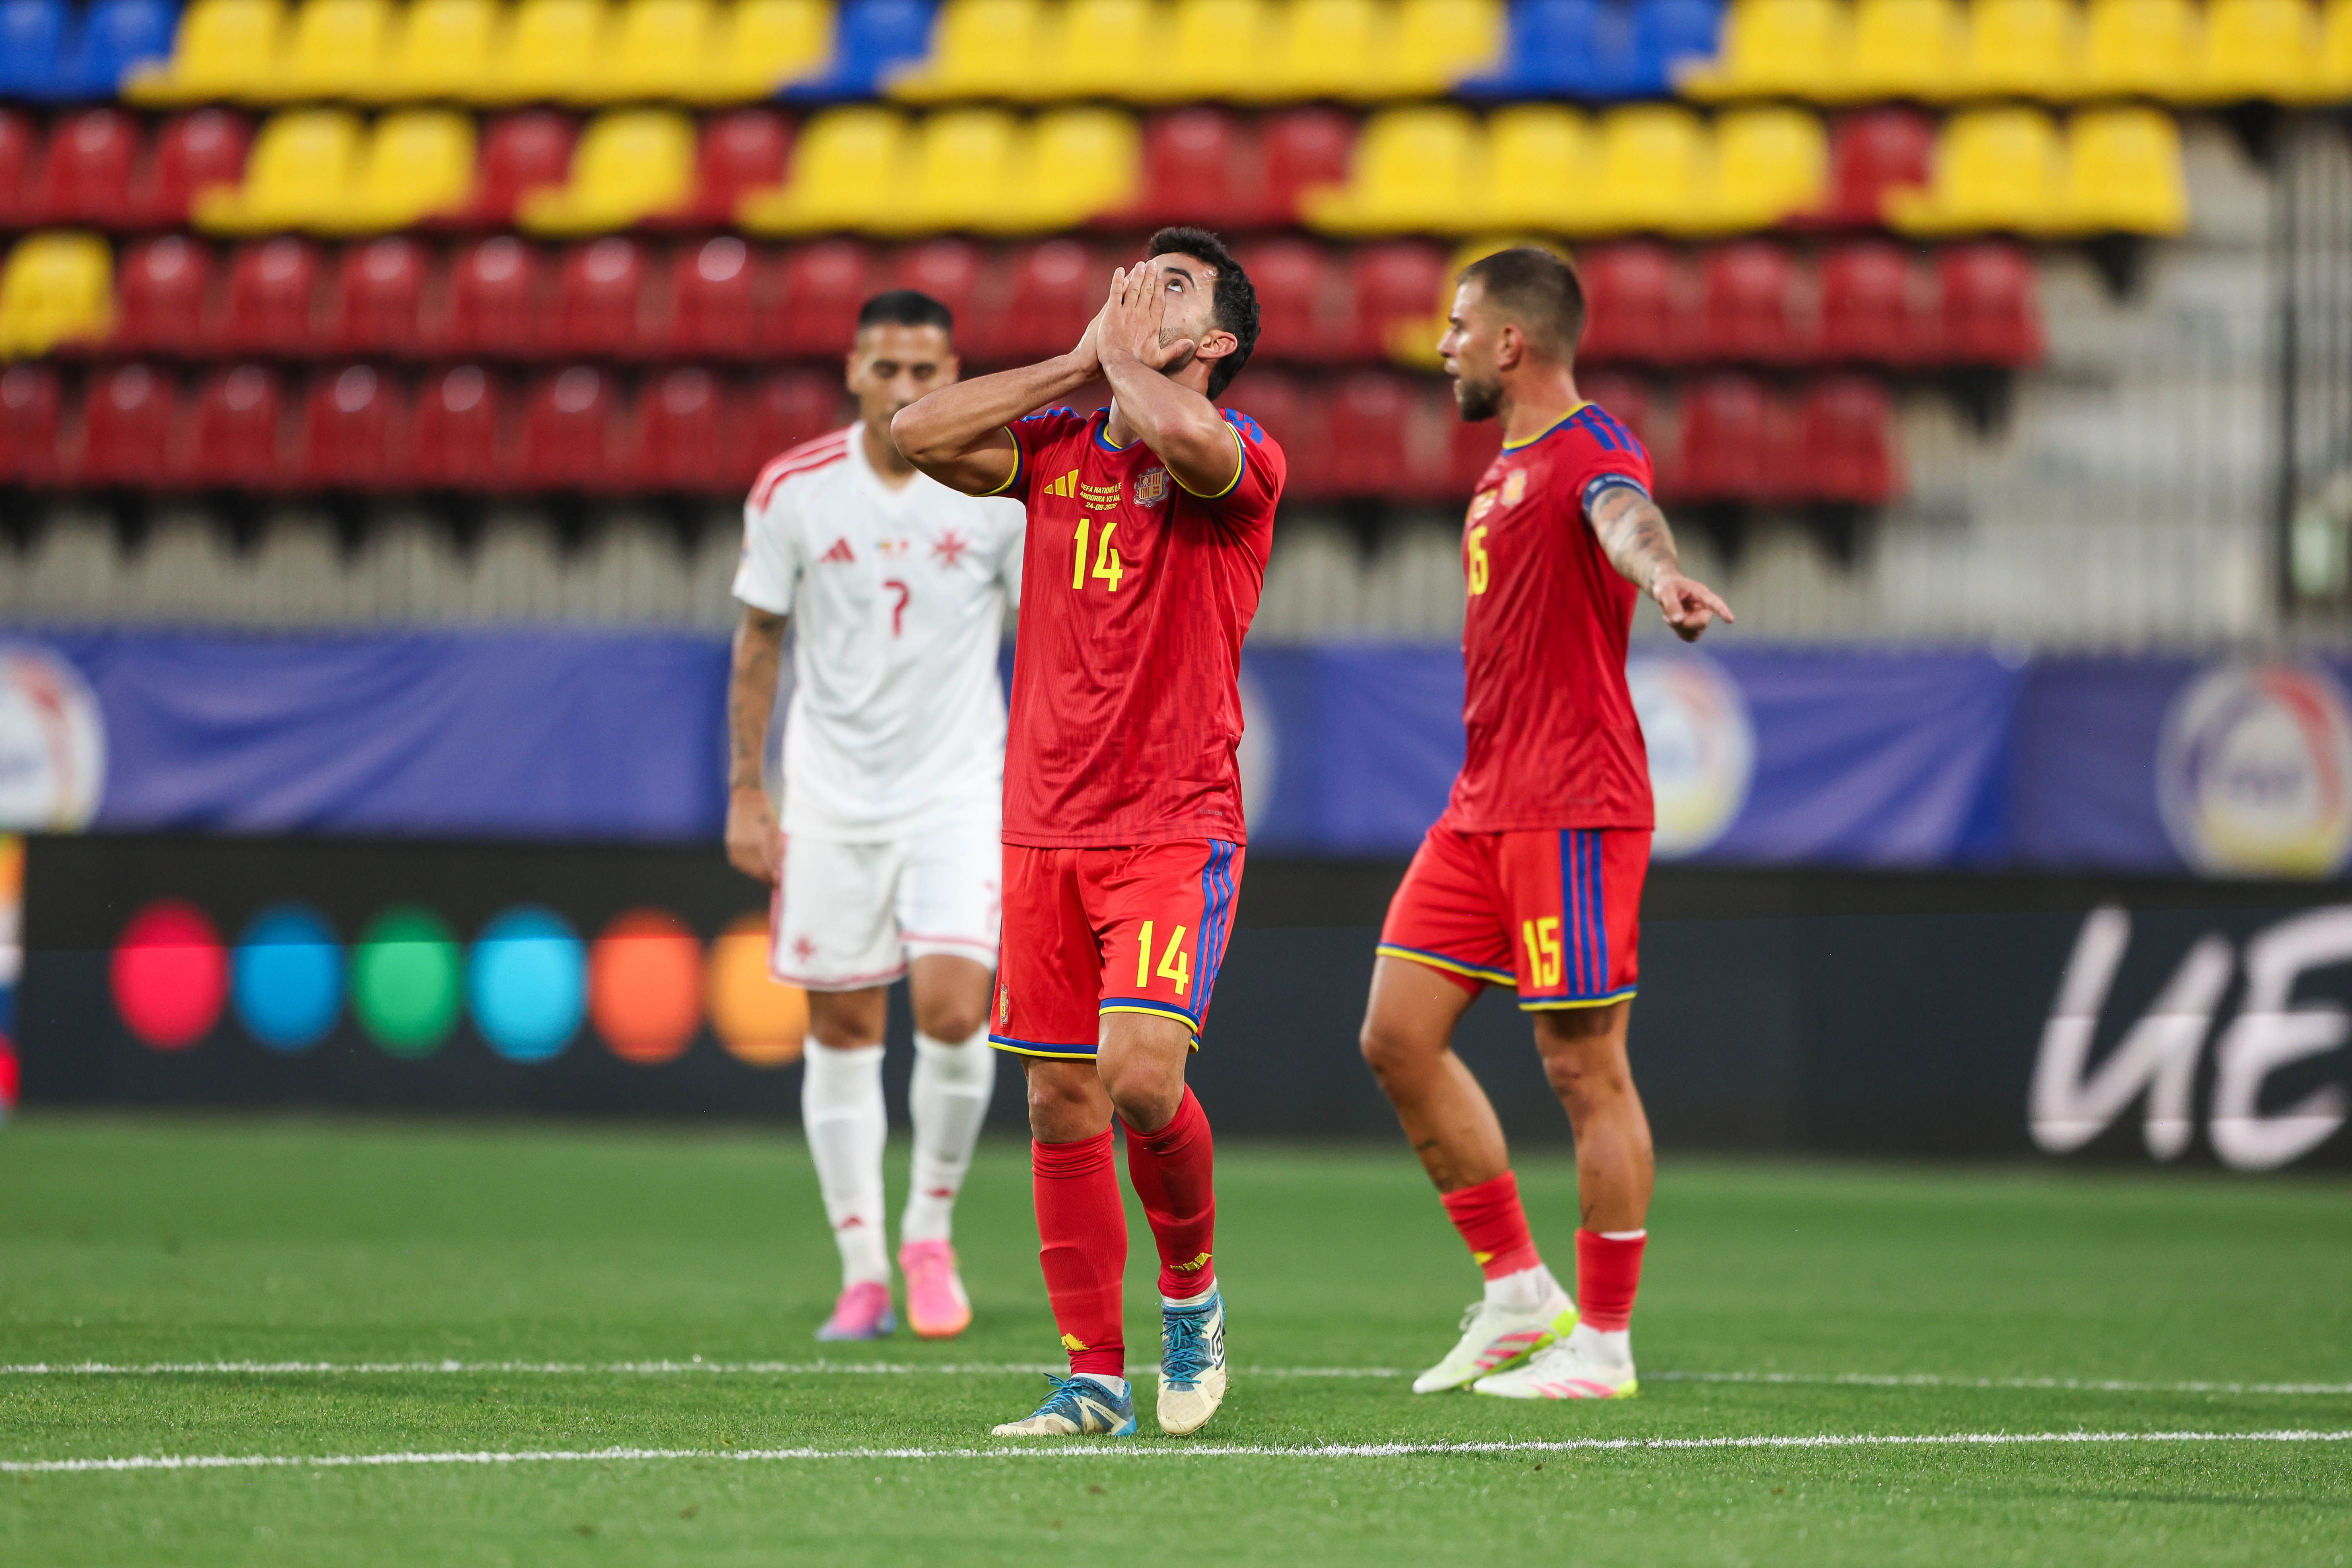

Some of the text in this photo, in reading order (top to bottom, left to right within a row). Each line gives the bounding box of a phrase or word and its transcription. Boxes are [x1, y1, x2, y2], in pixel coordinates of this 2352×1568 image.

[1079, 491, 1105, 502] ANDORRA
[1081, 482, 1093, 492] UEFA
[1094, 485, 1114, 494] NATIONS
[1072, 518, 1123, 592] 14
[884, 579, 910, 637] 7
[1136, 920, 1189, 995] 14
[1522, 916, 1561, 989] 15
